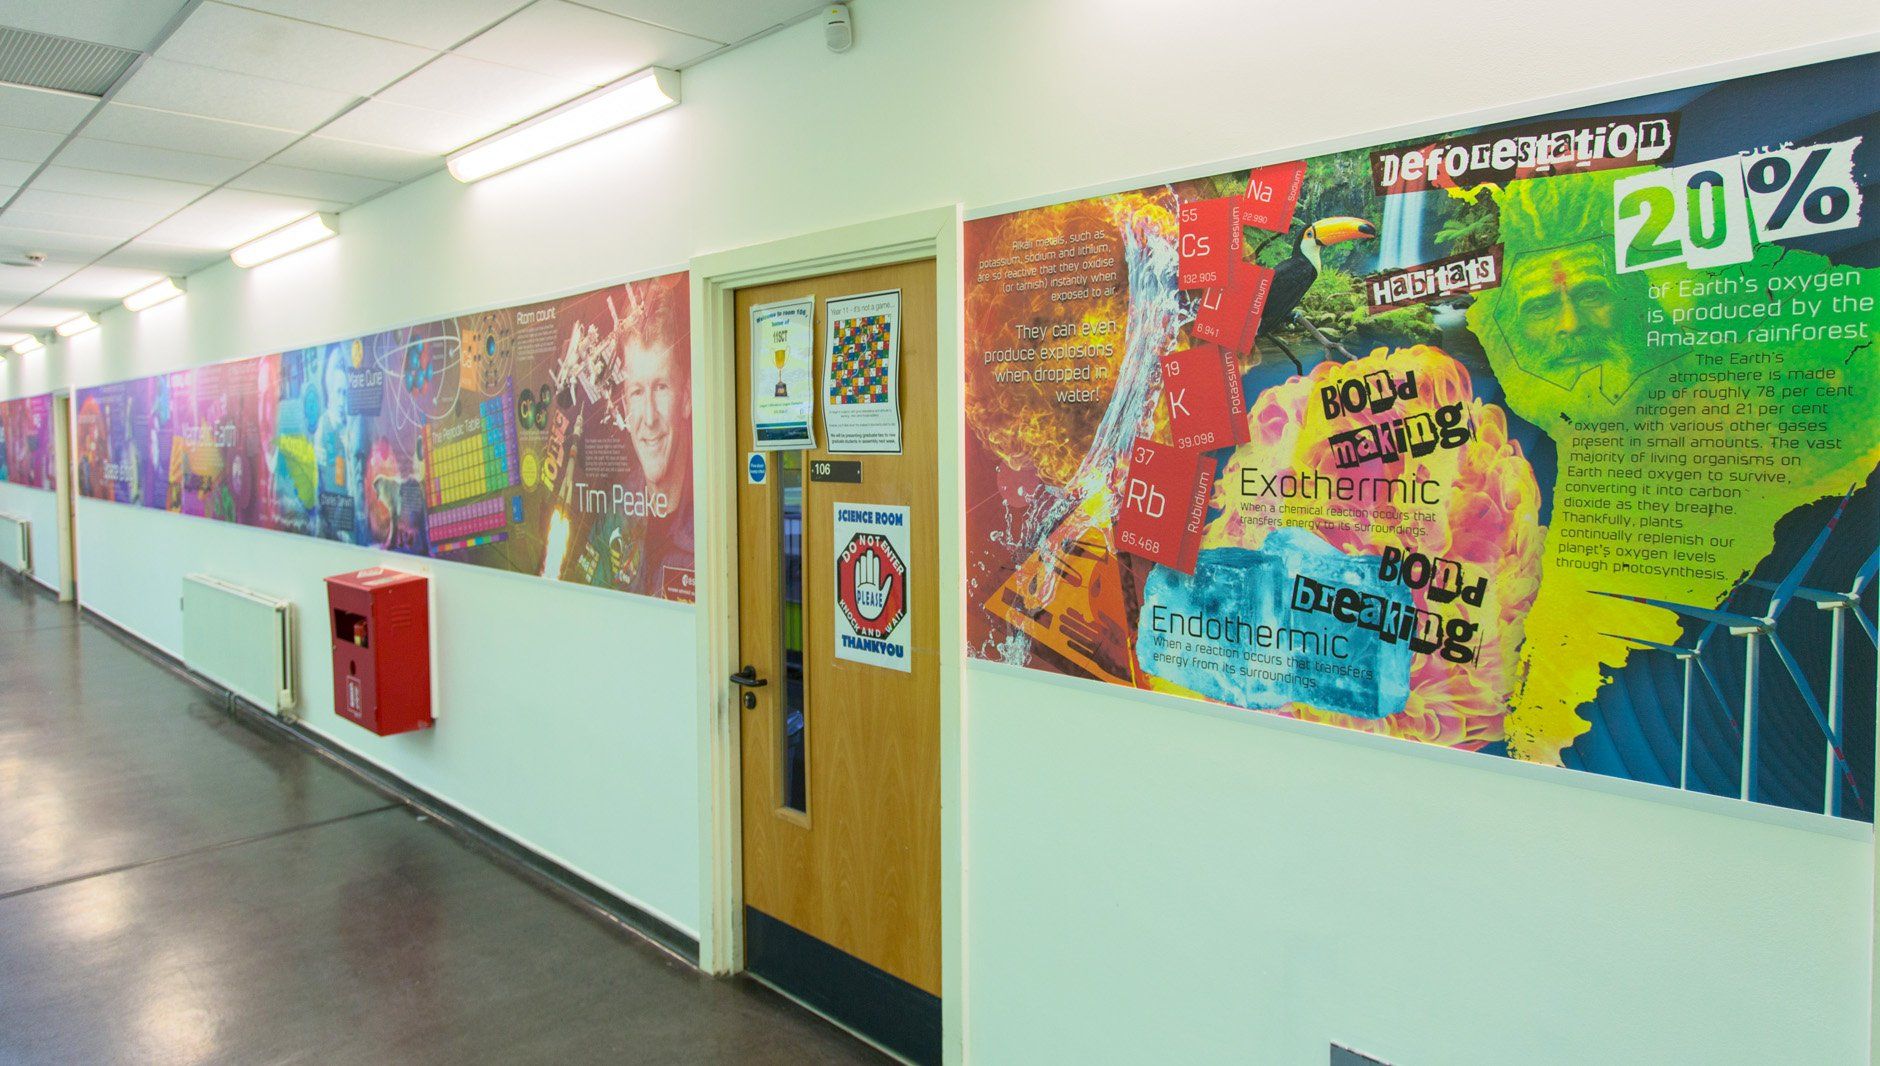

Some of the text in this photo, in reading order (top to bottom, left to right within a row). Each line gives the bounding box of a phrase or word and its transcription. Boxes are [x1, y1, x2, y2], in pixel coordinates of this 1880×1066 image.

[1380, 119, 1670, 186] Deforestation
[1248, 179, 1272, 202] Na
[1288, 170, 1302, 202] Sodium
[1182, 208, 1198, 222] 55
[1242, 212, 1268, 224] 22.990
[1617, 148, 1851, 268] 20%
[1230, 206, 1240, 250] Caesium
[1012, 231, 1091, 250] Alkali metals, such
[1182, 233, 1210, 258] Cs
[980, 244, 1111, 269] potassium, sodium lithium,
[1005, 258, 1114, 280] reactive that they oxidise
[1183, 272, 1217, 284] 132.905
[1016, 272, 1116, 291] tarnish) instantly when
[1373, 256, 1495, 305] Habitats
[1648, 271, 1860, 300] of Earth's oxygen
[1052, 286, 1118, 302] exposed air.
[1203, 287, 1224, 310] Li
[1251, 278, 1268, 315] Lithium
[536, 308, 556, 322] count
[1672, 296, 1874, 324] produced by the
[1016, 320, 1116, 340] They can even
[1647, 322, 1869, 347] Amazon rainforest
[984, 343, 1114, 364] produce explosions
[1696, 352, 1784, 365] The Earth's
[995, 365, 1090, 382] when dropped
[1165, 361, 1180, 377] 19
[1668, 368, 1836, 386] atmosphere made
[1225, 352, 1241, 414] Potassium
[1693, 385, 1854, 400] roughly 78 cent
[1056, 387, 1100, 402] water!
[1169, 388, 1190, 418] K
[1636, 402, 1829, 418] nitrogen and 21 cent
[1328, 402, 1471, 469] making
[1574, 420, 1826, 434] oxygen, with various other gases
[1178, 432, 1214, 449] 39.098
[1572, 436, 1842, 450] present small amounts. vast
[1135, 446, 1154, 466] 37
[1570, 452, 1774, 468] majority living organisms
[814, 464, 830, 475] 106
[1568, 466, 1791, 484] Earth need oxygen survive,
[1241, 468, 1440, 504] Exothermic
[1566, 482, 1742, 498] converting into carbon
[575, 483, 668, 518] Tim Peake
[1126, 478, 1166, 518] Rb
[1188, 472, 1210, 533] Rubidium
[1564, 497, 1737, 516] dioxide they breathe.
[838, 509, 903, 526] SCIENCE ROOM
[1240, 502, 1436, 522] When chemical reaction occurs that
[1562, 512, 1683, 528] Thankfully, plants
[1240, 516, 1428, 537] transfers energy surroundings.
[1122, 531, 1160, 554] 85.468
[1560, 528, 1704, 547] continually replenish
[842, 534, 904, 576] DO NOT ENTER
[1558, 542, 1716, 563] planet's oxygen levels
[1556, 557, 1728, 580] through photosynthesis.
[857, 590, 883, 608] PLEASE
[840, 598, 904, 638] KNOCK AND WAIT
[1291, 575, 1479, 664] breaking
[1152, 606, 1348, 659] Endothermic
[842, 635, 904, 658] THANKYOU
[1152, 636, 1374, 680] When reaction occurs that transfers
[1154, 653, 1318, 688] energy from surroundings.
